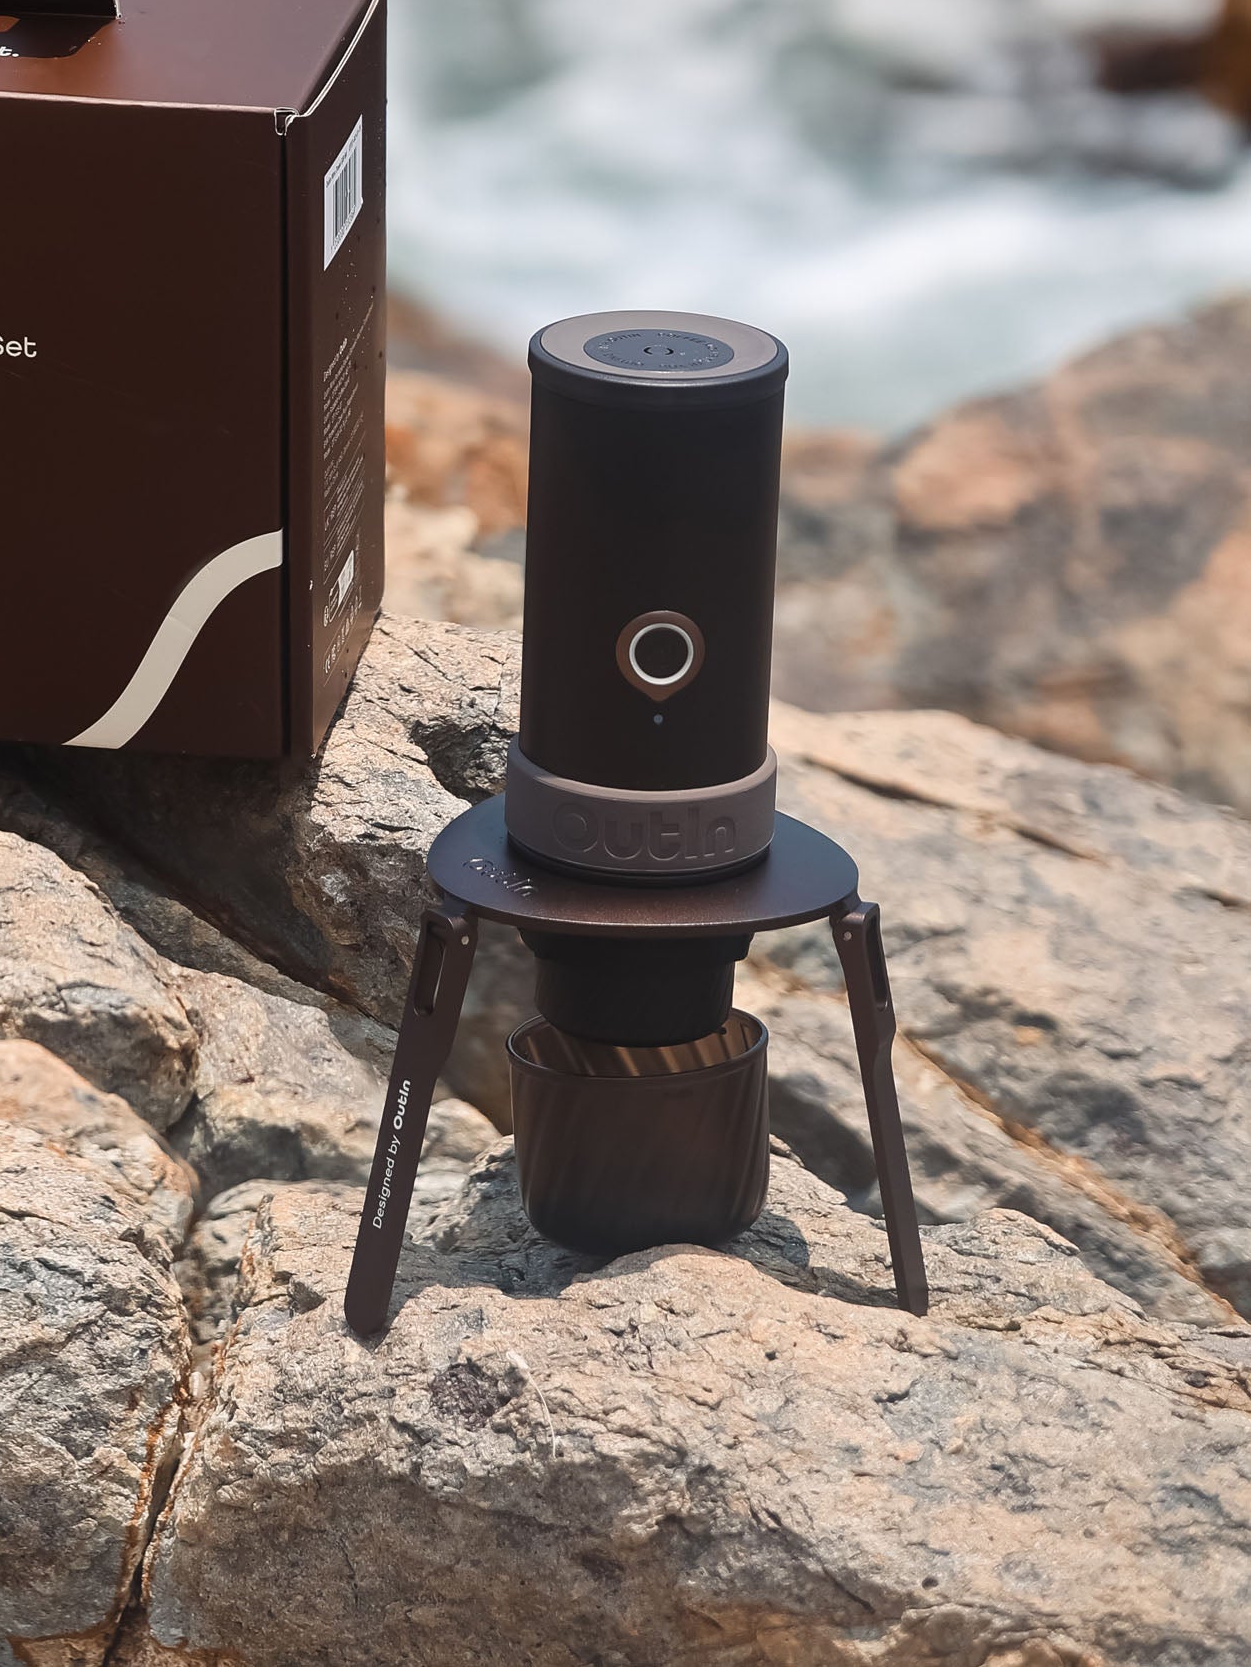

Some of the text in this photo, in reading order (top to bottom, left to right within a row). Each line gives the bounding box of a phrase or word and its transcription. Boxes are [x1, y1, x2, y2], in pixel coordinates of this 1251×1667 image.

[551, 802, 737, 861] OutIn
[372, 1079, 411, 1229] Designed by OutIn
